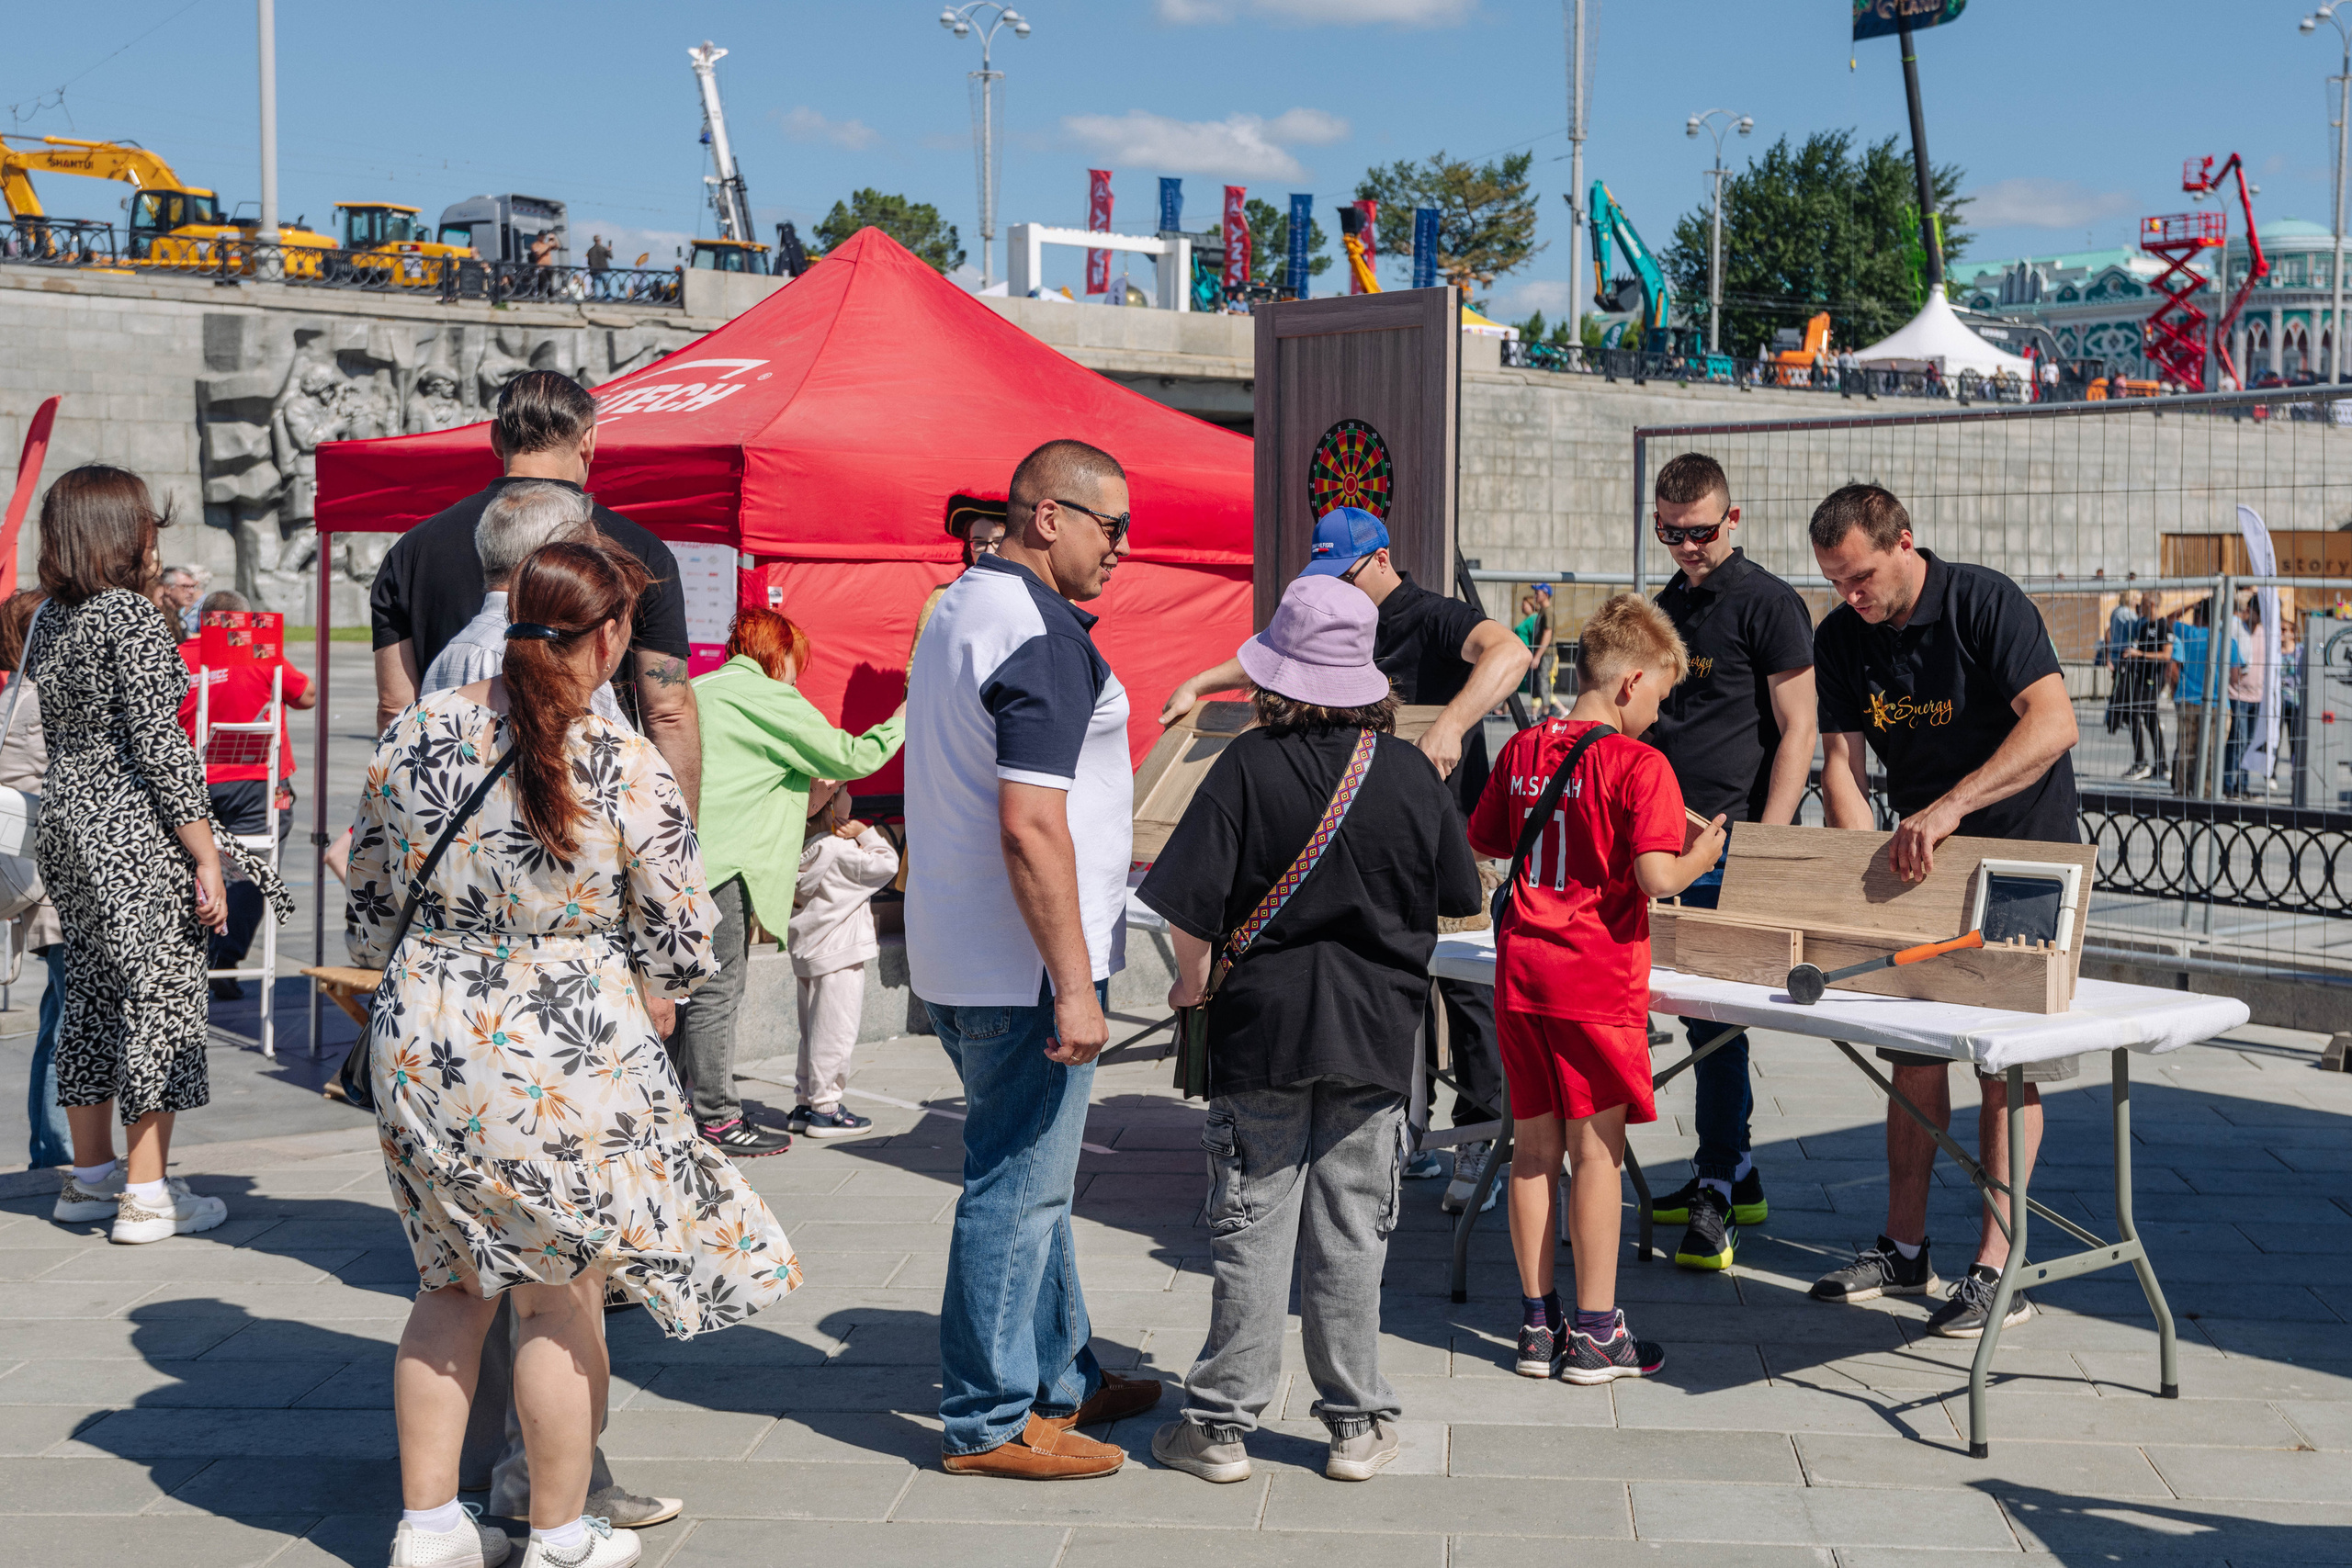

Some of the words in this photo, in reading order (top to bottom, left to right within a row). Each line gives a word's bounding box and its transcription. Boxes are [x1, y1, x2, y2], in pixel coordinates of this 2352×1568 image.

[1092, 209, 1107, 286] SAY
[2282, 558, 2350, 576] story
[1510, 775, 1582, 798] M.SAAH
[1524, 807, 1566, 891] 11
